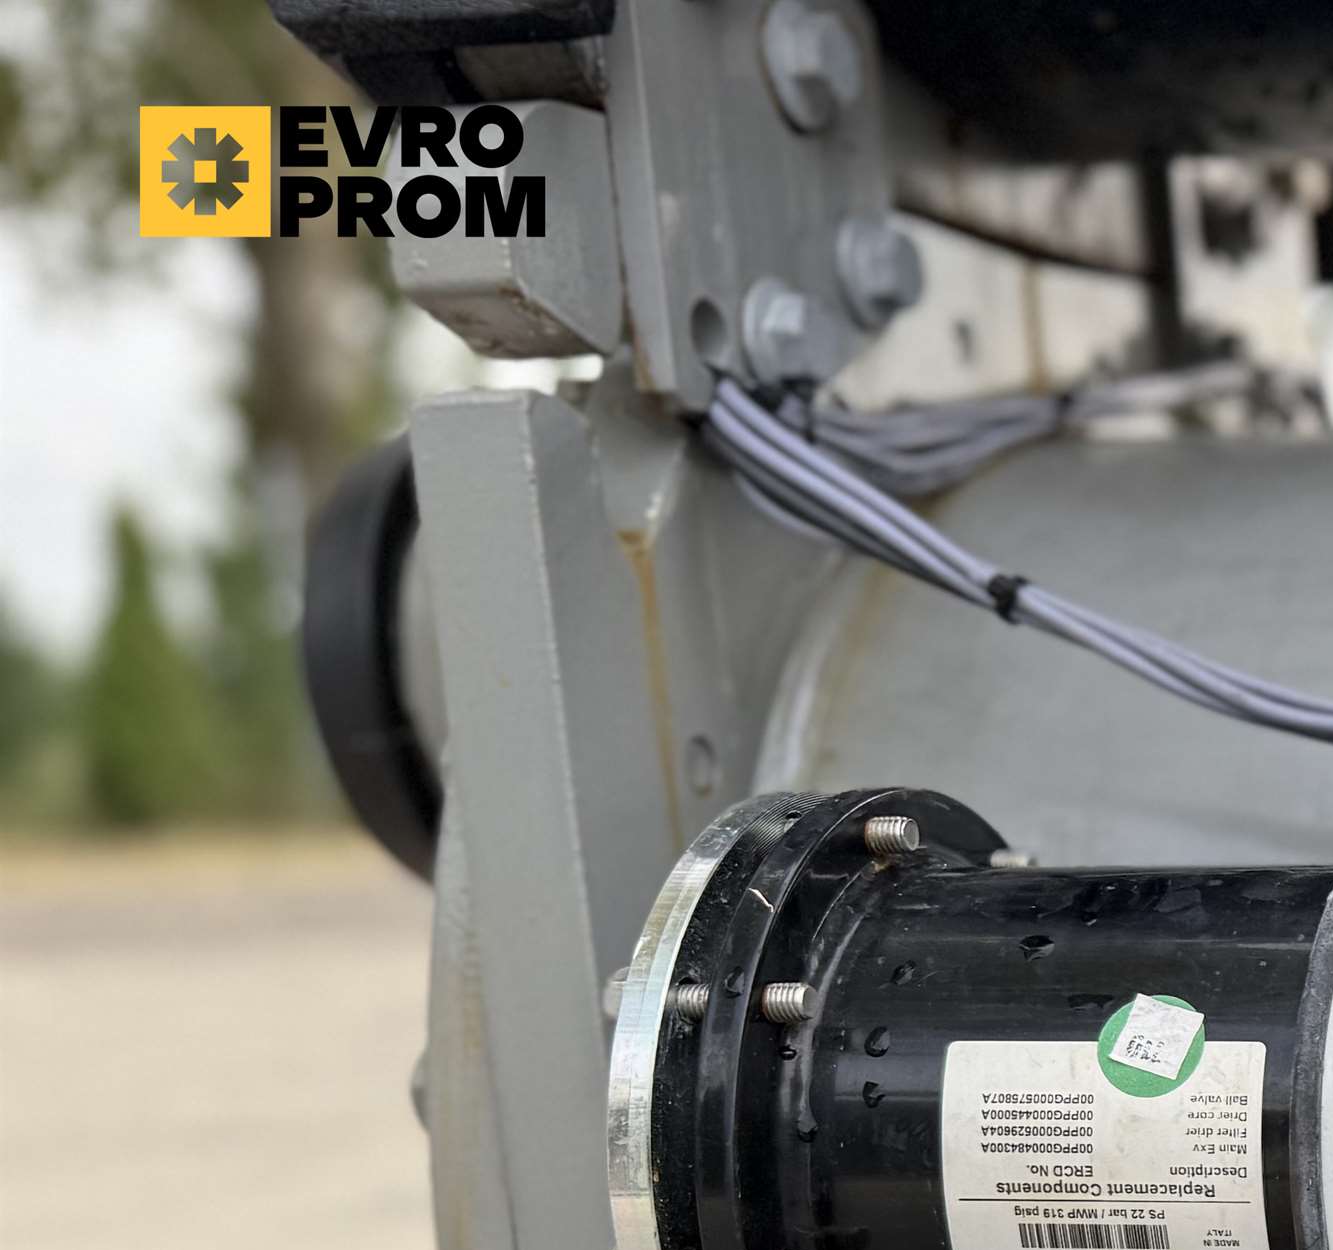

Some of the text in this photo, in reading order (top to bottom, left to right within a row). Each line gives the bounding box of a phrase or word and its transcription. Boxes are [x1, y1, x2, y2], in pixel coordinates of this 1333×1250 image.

[1190, 1094, 1248, 1106] Ball valve
[1186, 1111, 1248, 1122] Drier core
[1184, 1127, 1247, 1138] Filter drier
[1192, 1143, 1248, 1155] Main Exv
[1025, 1164, 1094, 1177] ERCD No.
[1169, 1164, 1248, 1178] Description
[995, 1180, 1216, 1198] Replacement Components
[1014, 1205, 1040, 1218] psig
[1043, 1208, 1064, 1218] 319
[1067, 1208, 1098, 1219] MWP
[1108, 1208, 1128, 1219] bar
[1130, 1209, 1146, 1219] 22
[1148, 1209, 1166, 1220] PS
[1206, 1229, 1232, 1237] ITALY
[1203, 1239, 1240, 1247] MADE IN
